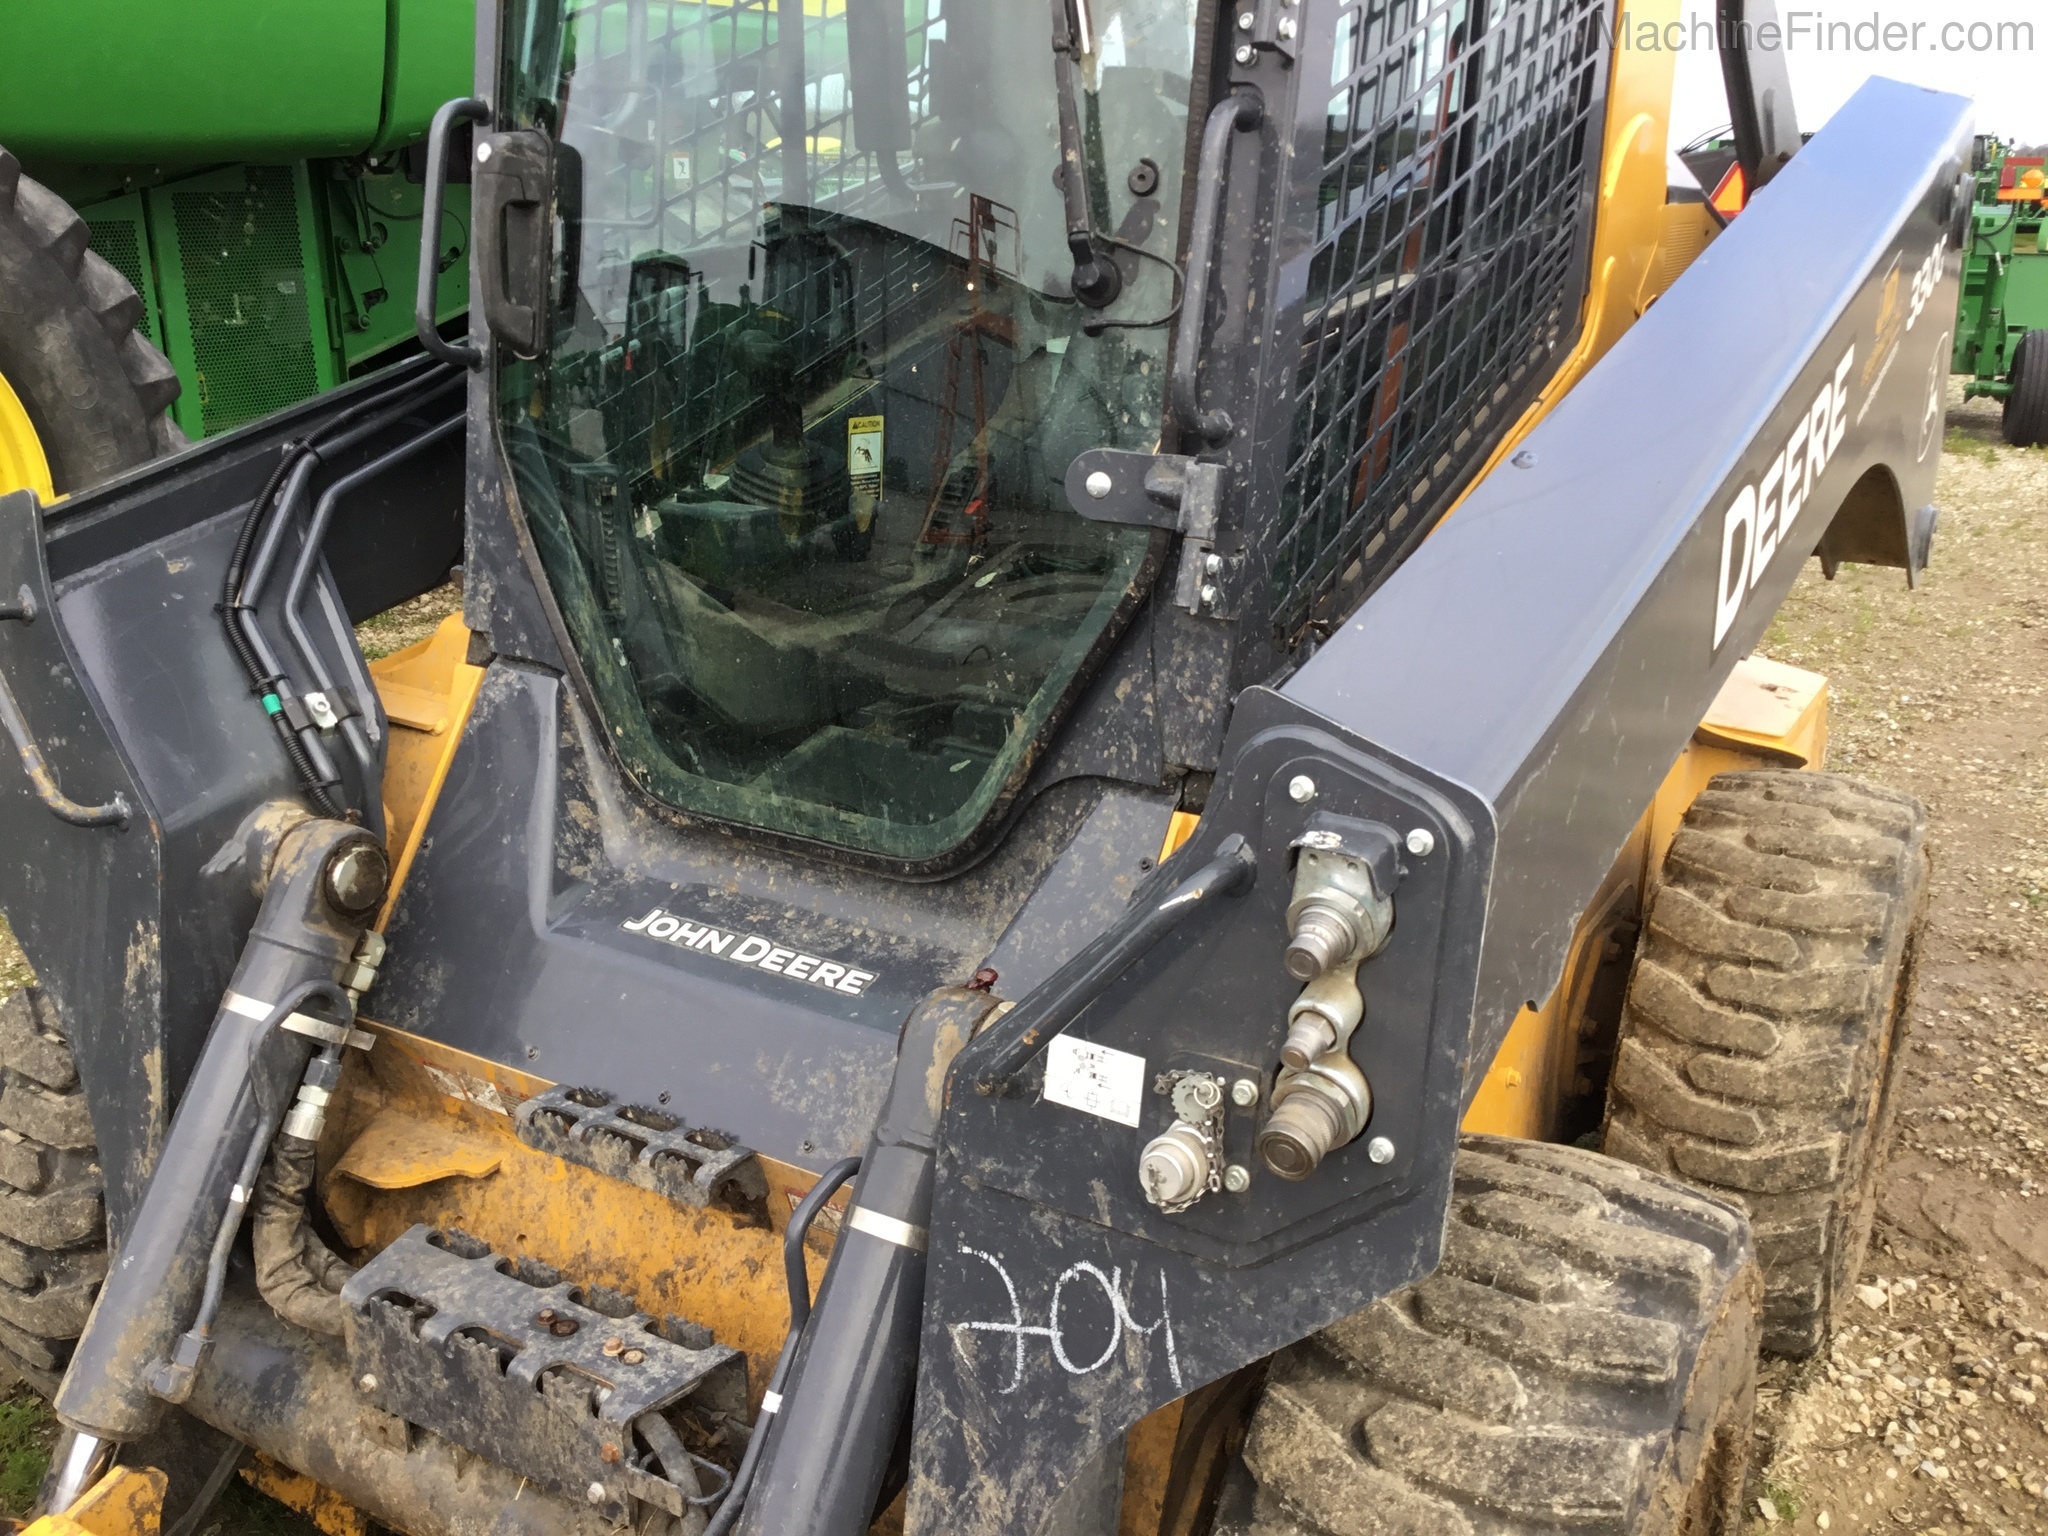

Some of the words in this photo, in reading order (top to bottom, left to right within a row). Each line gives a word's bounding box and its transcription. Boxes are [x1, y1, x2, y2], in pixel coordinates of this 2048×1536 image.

[857, 420, 881, 429] CAUTION
[1713, 343, 1855, 651] DEERE
[623, 909, 735, 955] JOHN
[729, 936, 874, 995] DEERE
